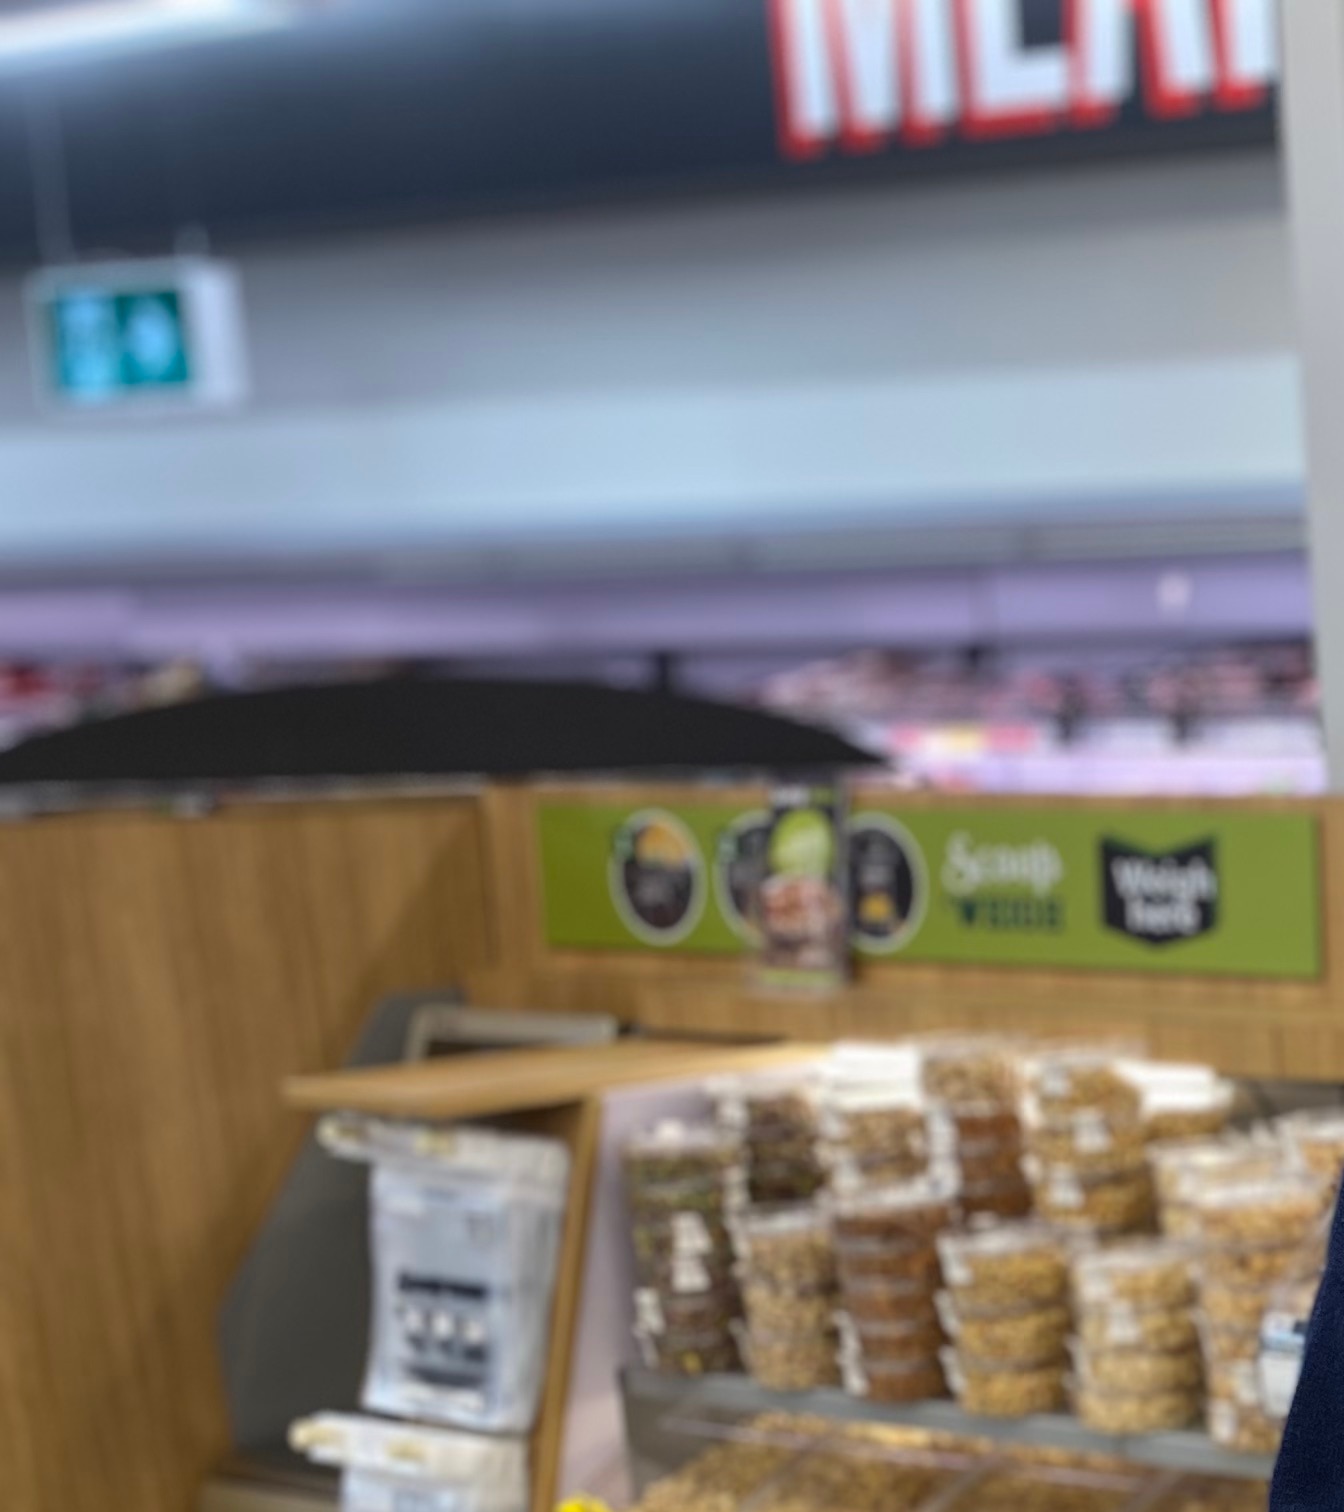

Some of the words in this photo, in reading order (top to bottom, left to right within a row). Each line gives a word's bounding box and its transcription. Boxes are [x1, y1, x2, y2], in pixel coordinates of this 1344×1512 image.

[942, 831, 1063, 896] Scoop
[1109, 854, 1218, 903] Weigh
[1122, 896, 1203, 936] here
